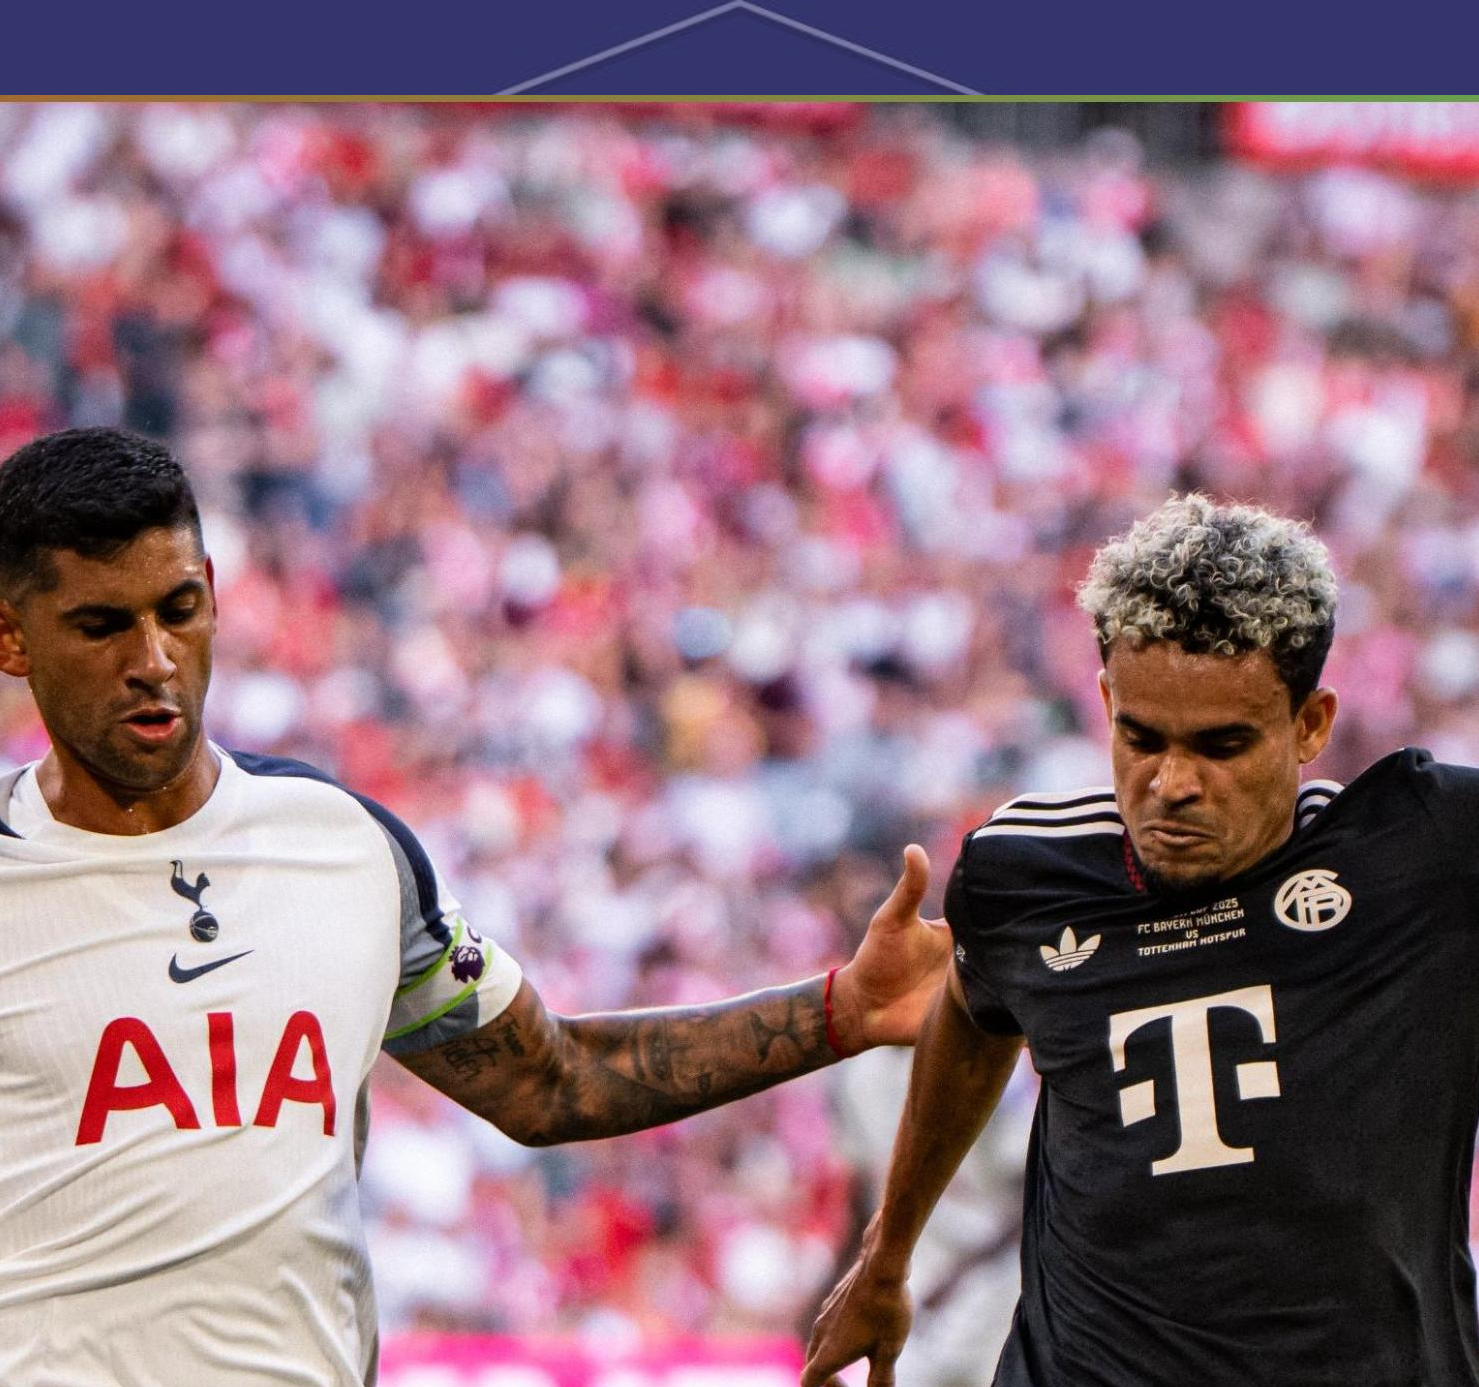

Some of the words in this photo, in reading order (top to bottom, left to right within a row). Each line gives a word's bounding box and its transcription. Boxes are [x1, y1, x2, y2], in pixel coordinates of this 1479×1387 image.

[1137, 923, 1151, 934] FC
[1153, 919, 1193, 933] BAYERN
[1196, 908, 1245, 927] MÜNCHEN
[1138, 939, 1197, 957] TOTTENHAM
[1200, 927, 1246, 945] HOTSPUR
[75, 1010, 337, 1147] AIA
[1108, 983, 1281, 1177] T
